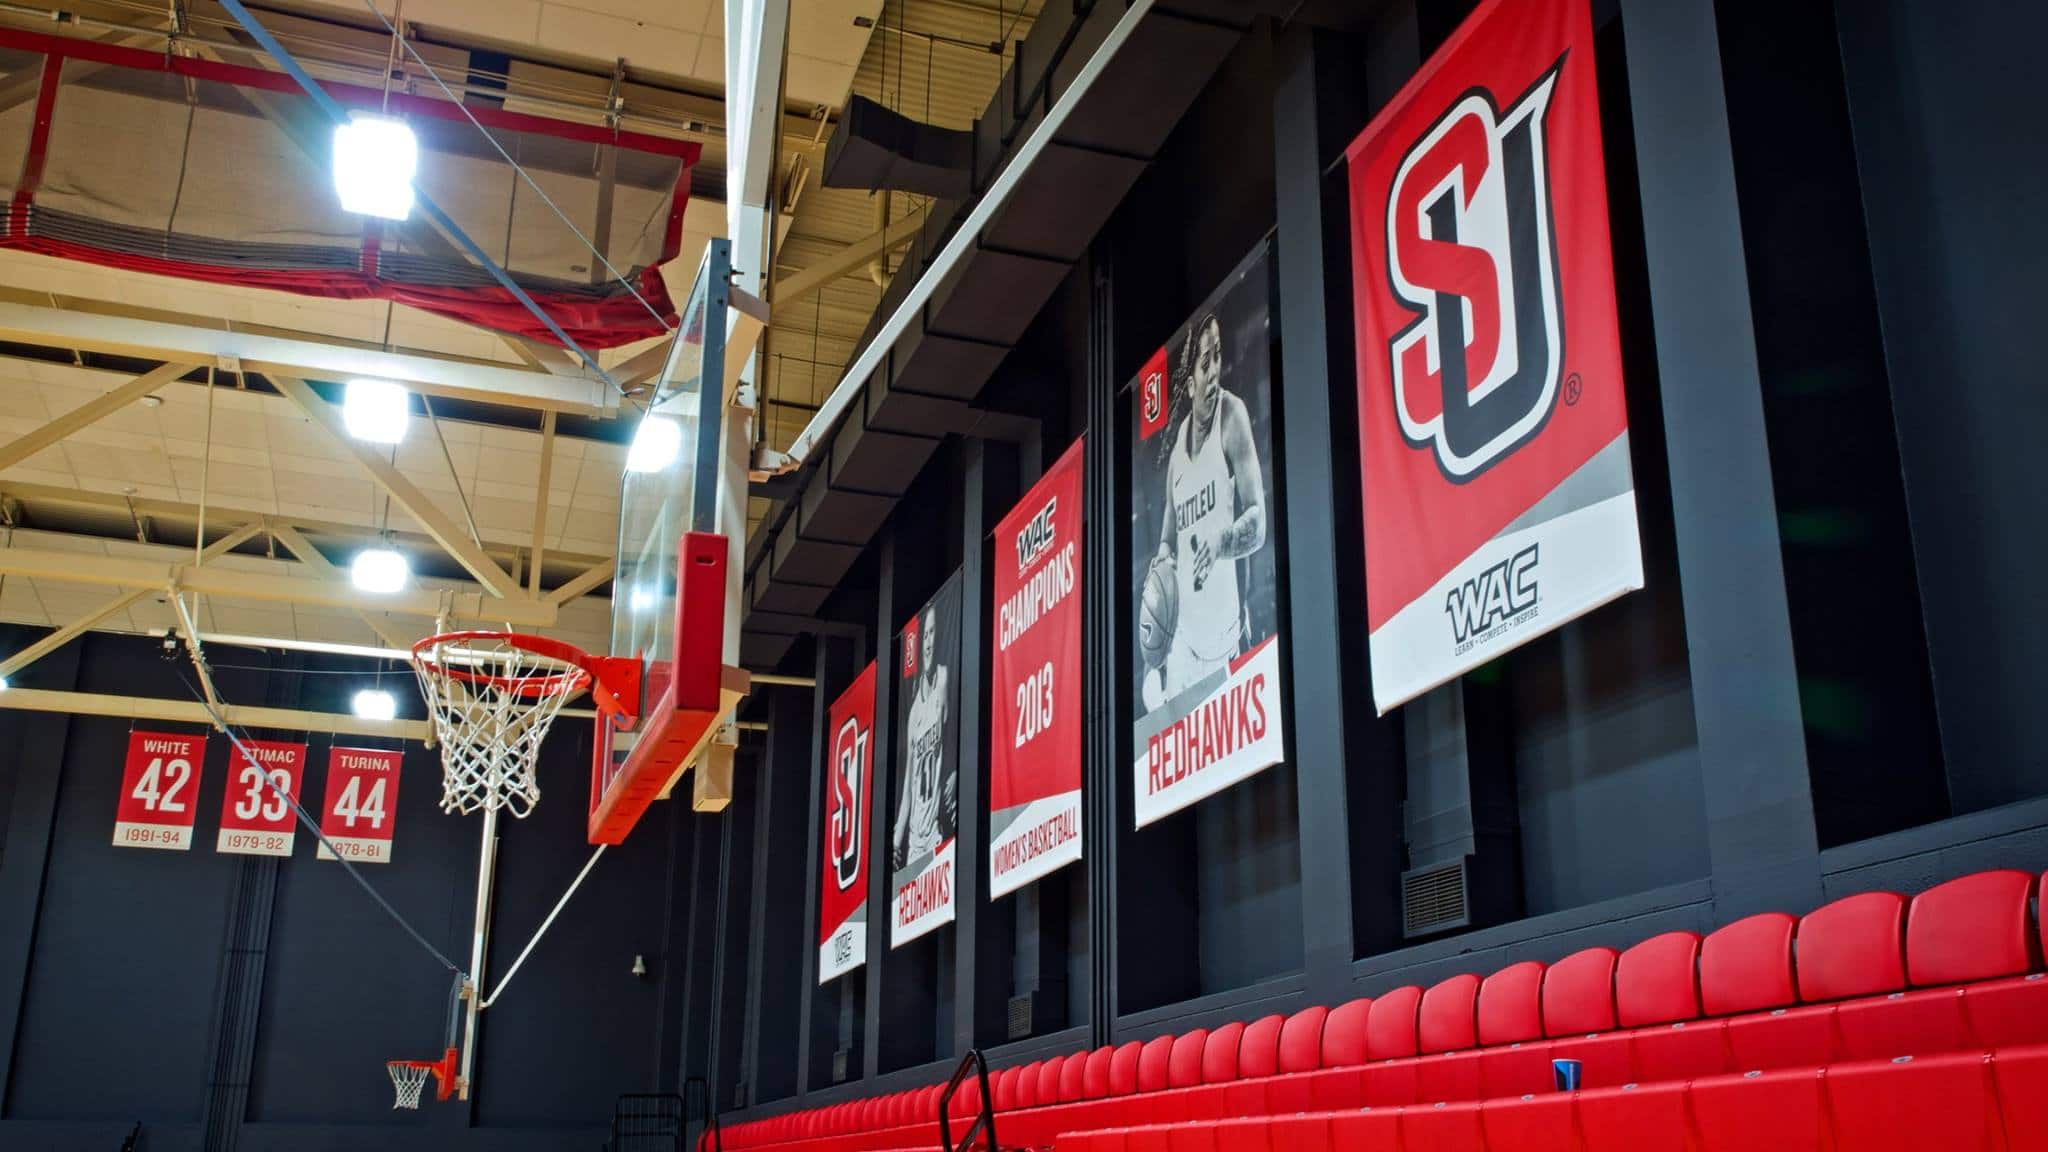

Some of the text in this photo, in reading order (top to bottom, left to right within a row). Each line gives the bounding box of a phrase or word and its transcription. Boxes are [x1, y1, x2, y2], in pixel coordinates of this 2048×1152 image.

[1016, 496, 1057, 571] WAC
[1000, 541, 1075, 651] CHAMPIONS
[1445, 542, 1539, 644] WAC
[1015, 661, 1053, 749] 2013
[1148, 673, 1266, 796] REDHAWKS
[144, 739, 190, 756] WHITE
[340, 755, 390, 771] TURINA
[131, 758, 191, 812] 42
[235, 768, 292, 822] 33
[333, 776, 387, 829] 44
[125, 829, 180, 844] 1991-94
[227, 835, 284, 850] 1979-82
[993, 805, 1078, 879] WOMEN'S BASKETBALL
[898, 861, 951, 928] REDHAWKS
